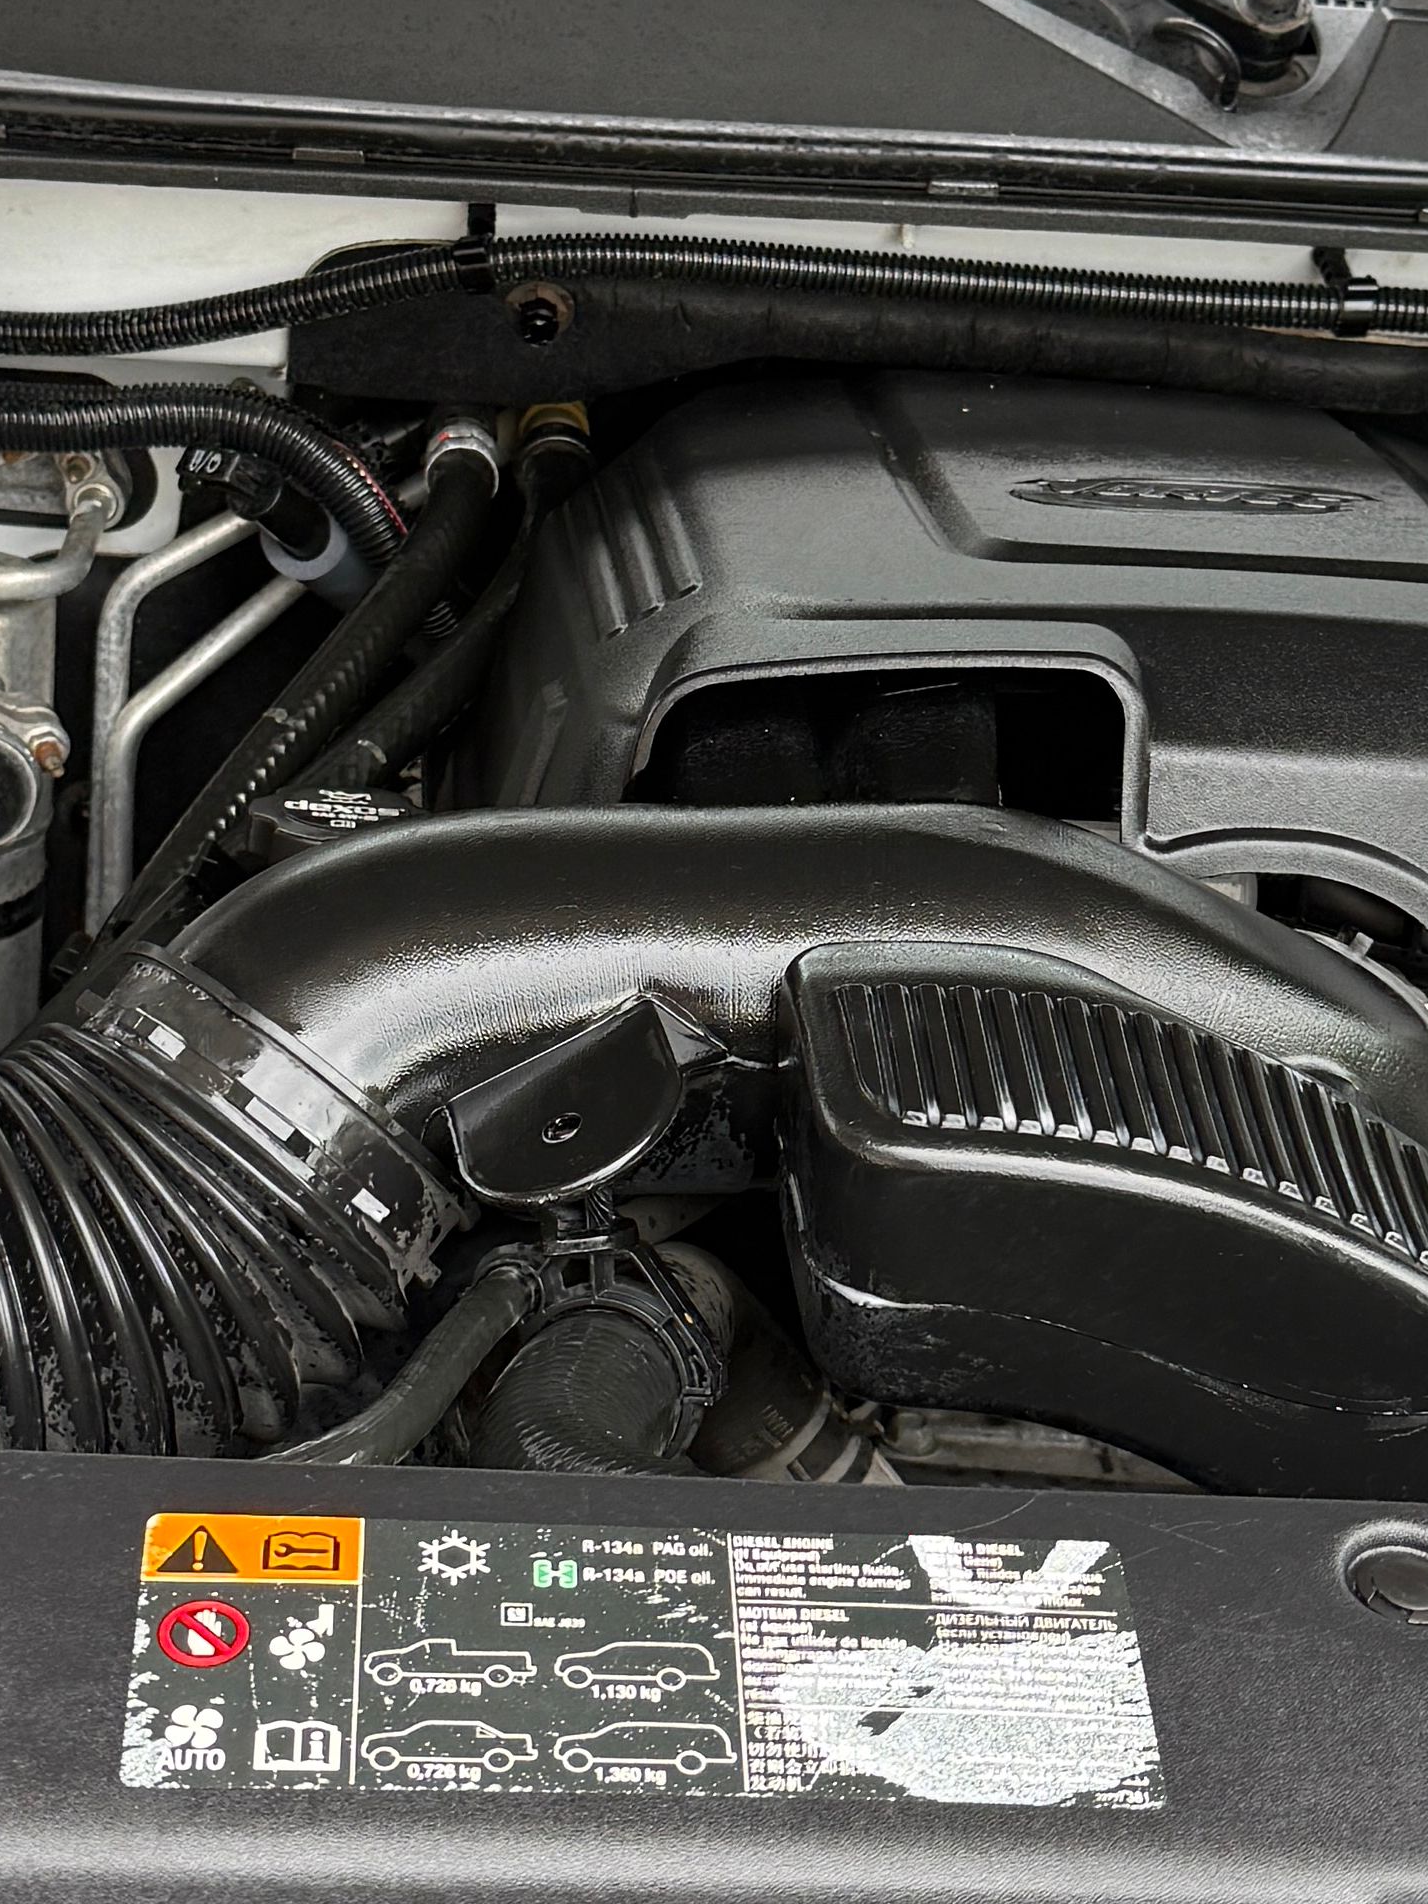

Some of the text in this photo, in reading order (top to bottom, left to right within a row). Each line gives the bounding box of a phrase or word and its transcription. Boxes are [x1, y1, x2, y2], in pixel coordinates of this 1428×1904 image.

[582, 1539, 714, 1558] R-134a PAG oil.
[732, 1536, 834, 1551] DIESEL ENGINE
[582, 1566, 645, 1583] R-134a
[690, 1571, 716, 1586] oil.
[735, 1574, 912, 1592] Immediate engine damage
[736, 1587, 762, 1598] can
[1032, 1615, 1119, 1632] ДВИГАТЕЛЬ
[459, 1678, 482, 1697] kg
[639, 1685, 662, 1703] kg
[154, 1748, 226, 1771] AUTO
[458, 1763, 482, 1783] kg
[644, 1767, 668, 1786] kg
